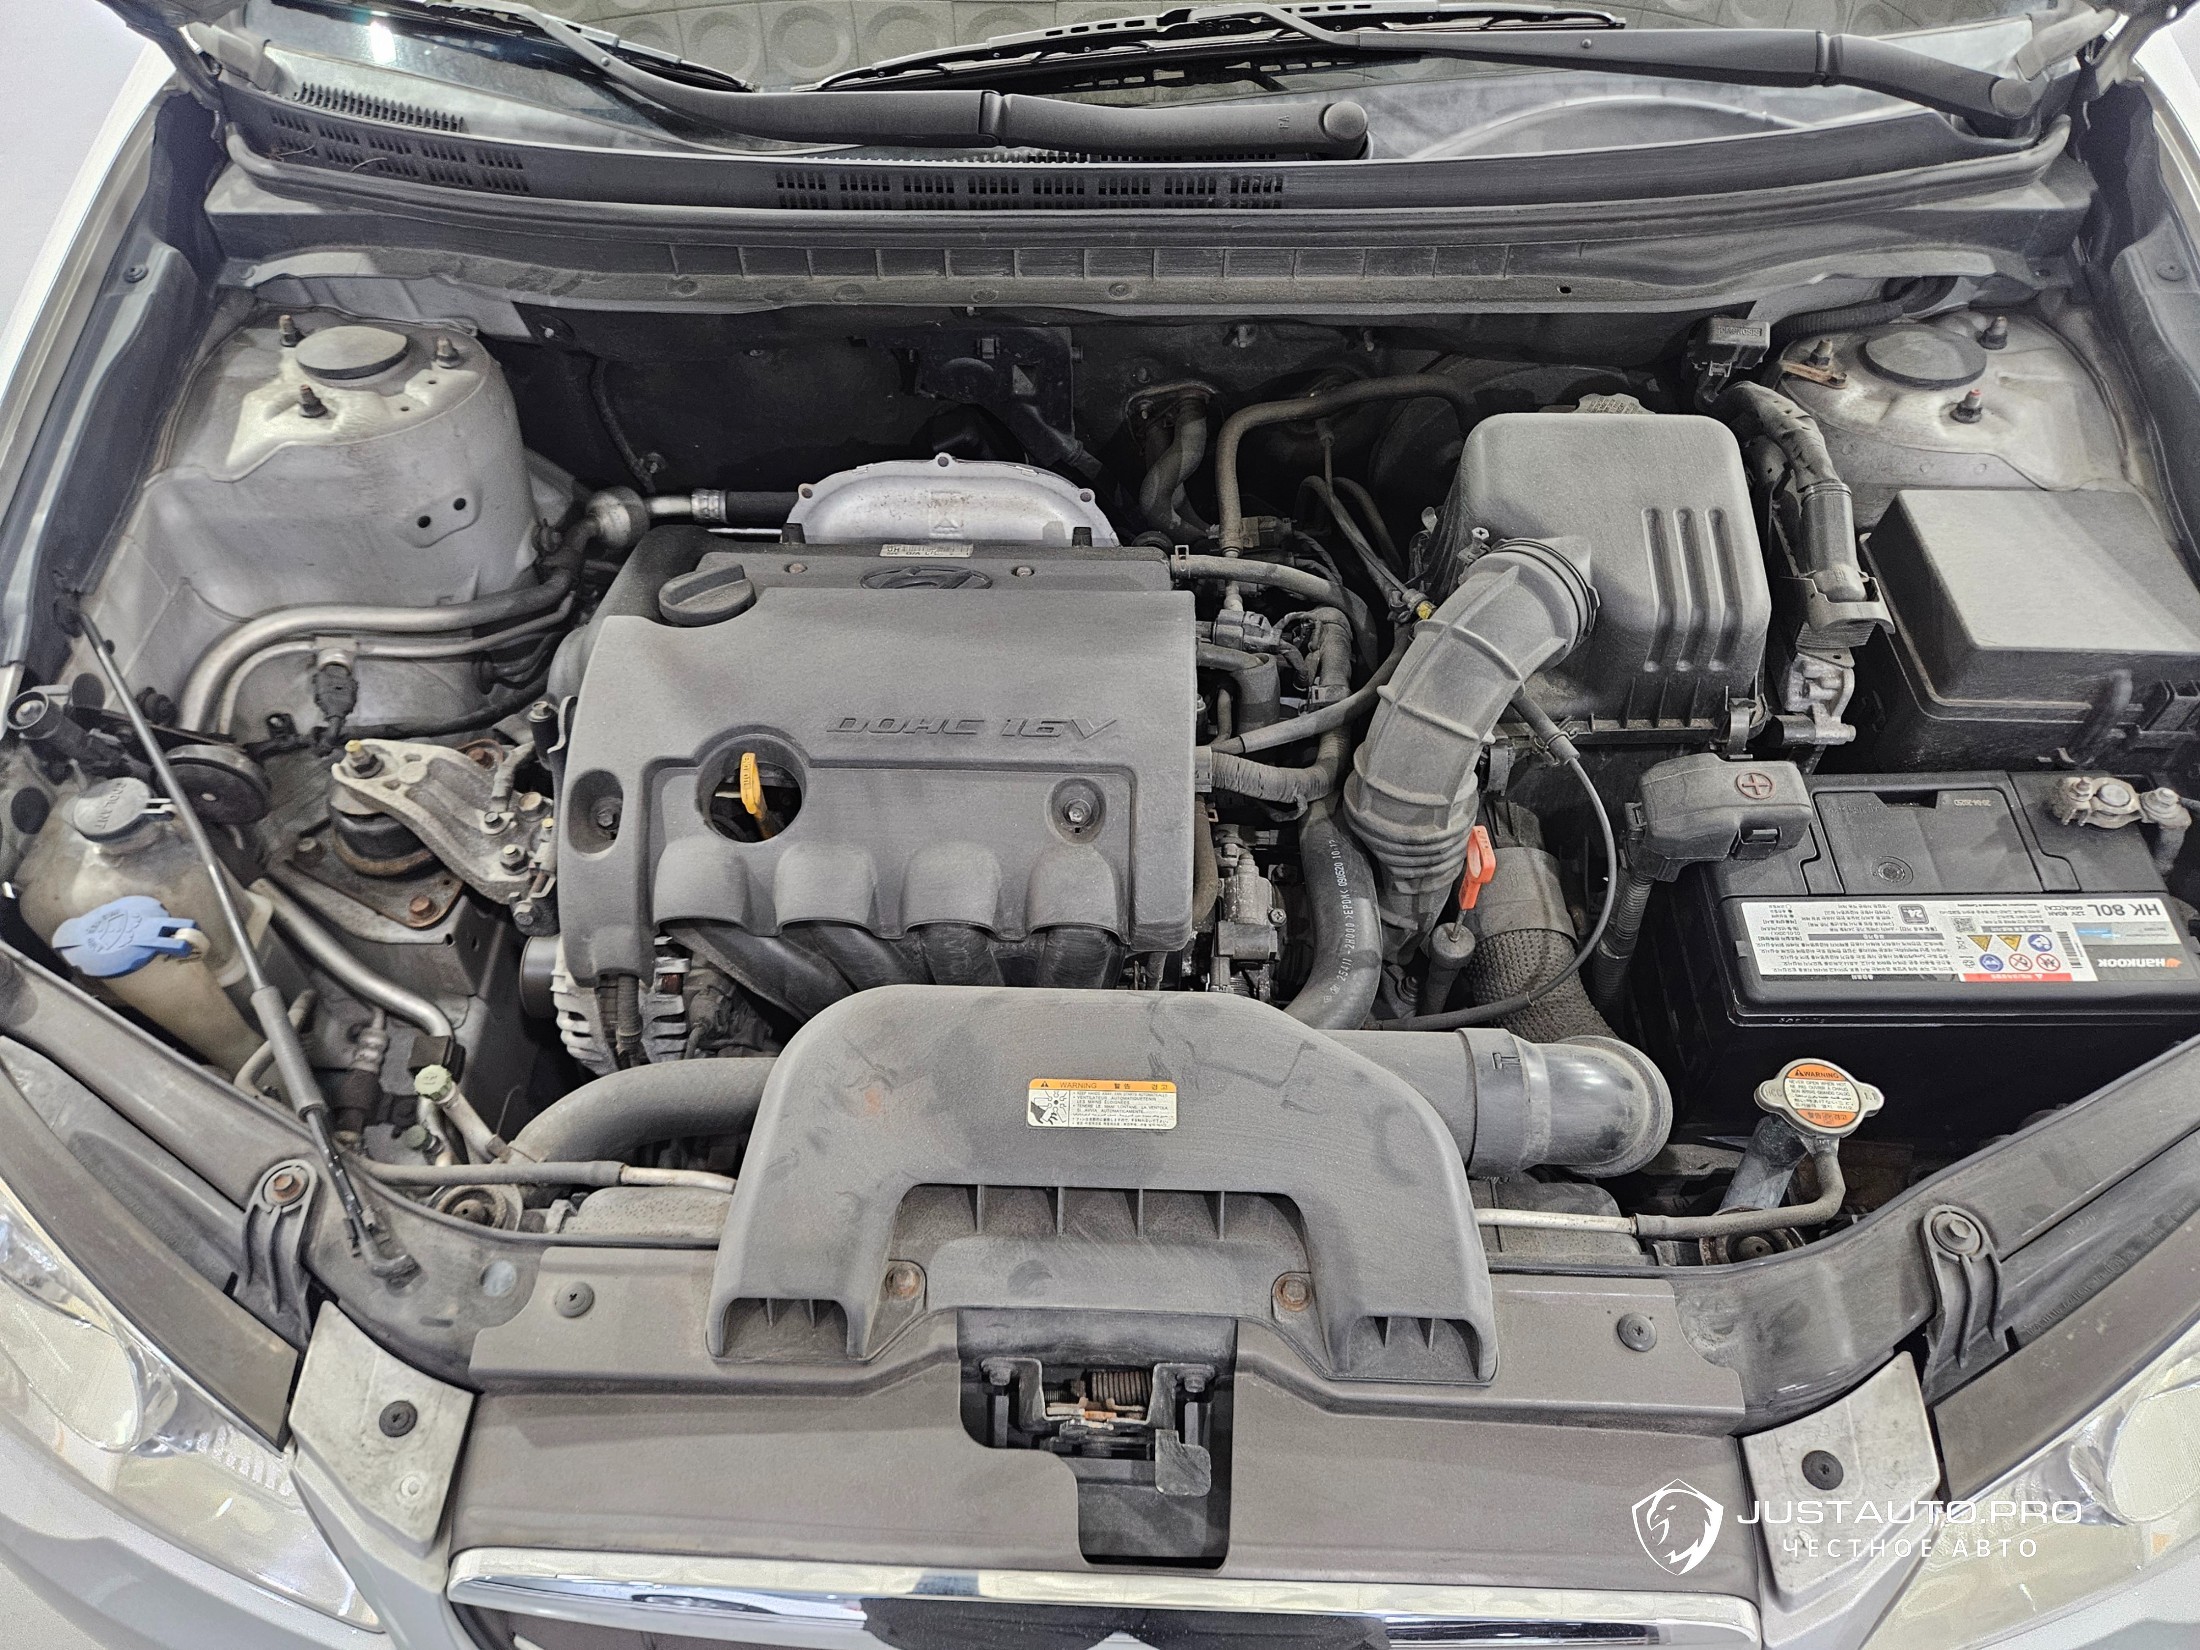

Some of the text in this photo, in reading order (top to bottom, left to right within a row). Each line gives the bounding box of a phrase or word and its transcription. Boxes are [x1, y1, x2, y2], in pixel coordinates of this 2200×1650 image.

[826, 717, 1117, 740] DOHC 16V
[2087, 902, 2161, 917] HK 80L
[1803, 1071, 1840, 1079] WARNING
[1060, 1081, 1098, 1089] WARNING
